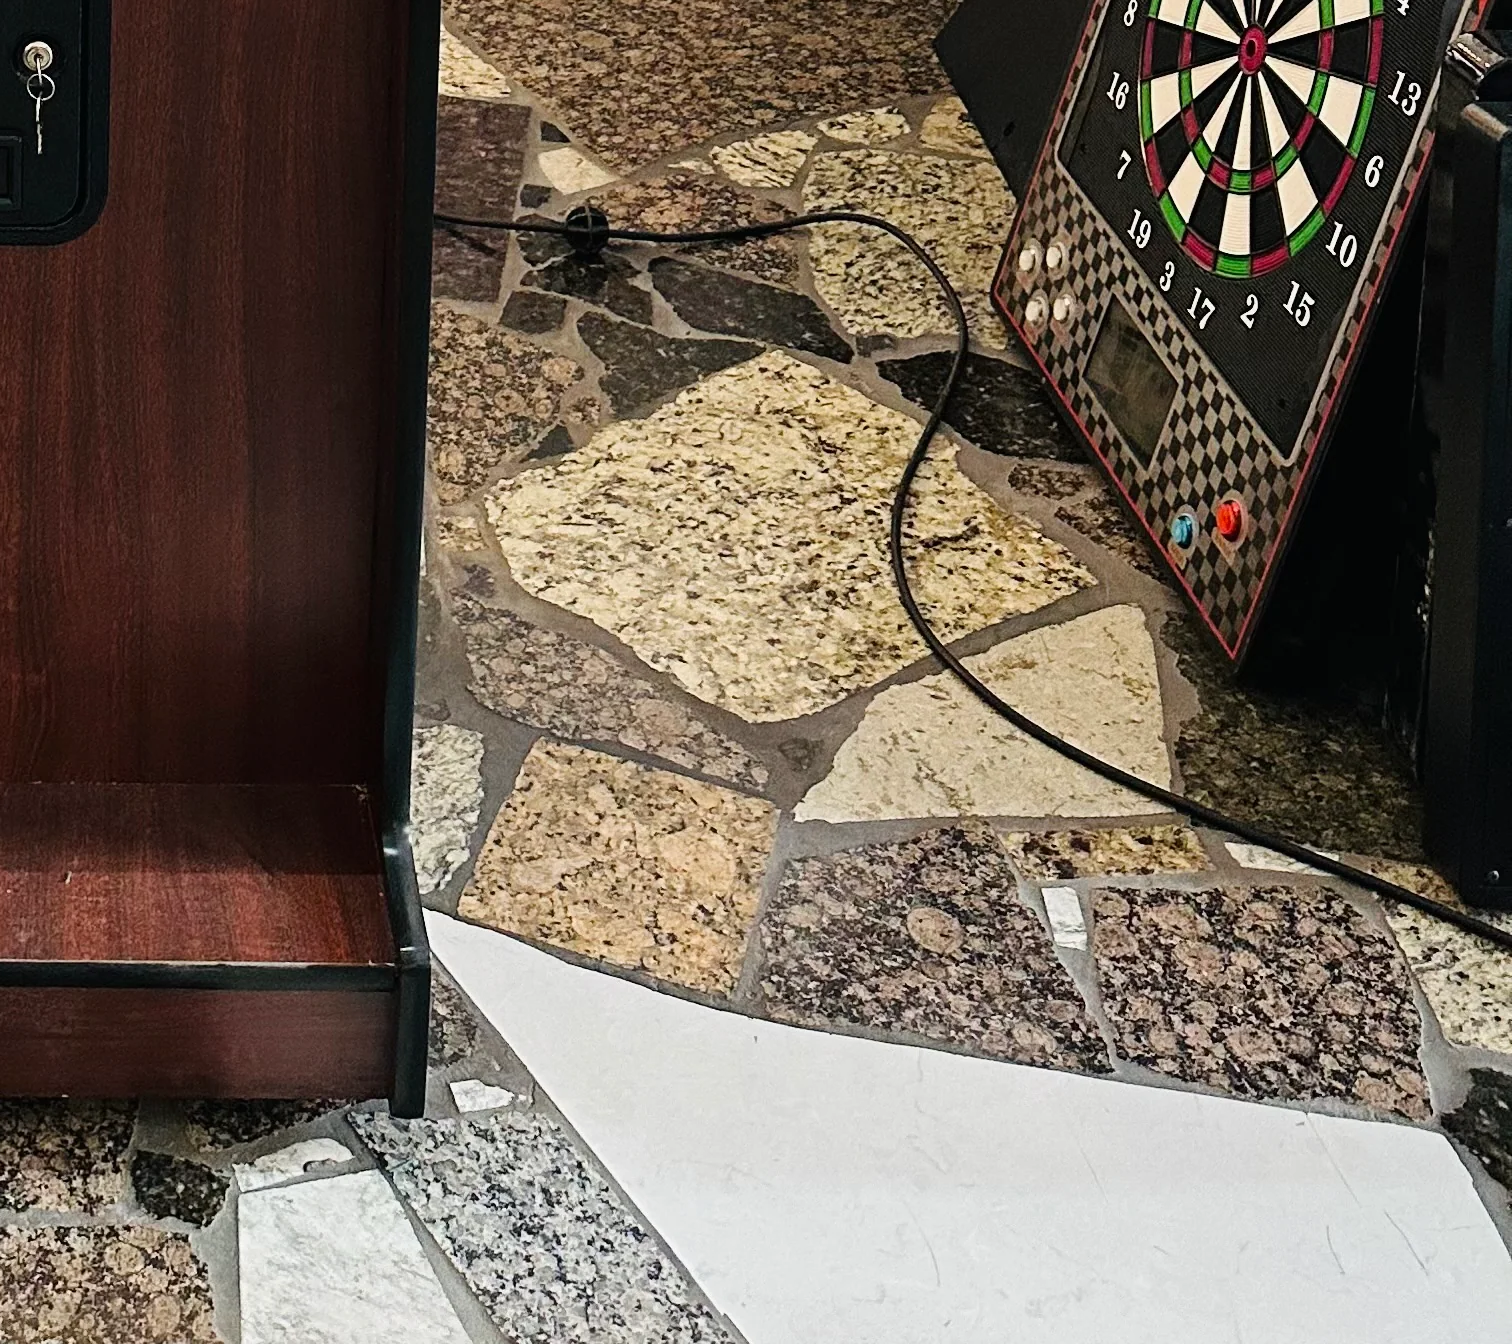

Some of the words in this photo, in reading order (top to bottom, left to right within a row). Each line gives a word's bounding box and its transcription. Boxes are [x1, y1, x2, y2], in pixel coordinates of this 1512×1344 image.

[1106, 71, 1130, 110] 16
[1387, 70, 1422, 117] 13
[1116, 149, 1132, 180] 7
[1364, 155, 1384, 188] 6
[1125, 208, 1152, 253] 19
[1325, 220, 1358, 268] 10
[1159, 260, 1175, 296] 3
[1186, 287, 1215, 331] 17
[1239, 293, 1259, 329] 2
[1282, 280, 1316, 327] 15
